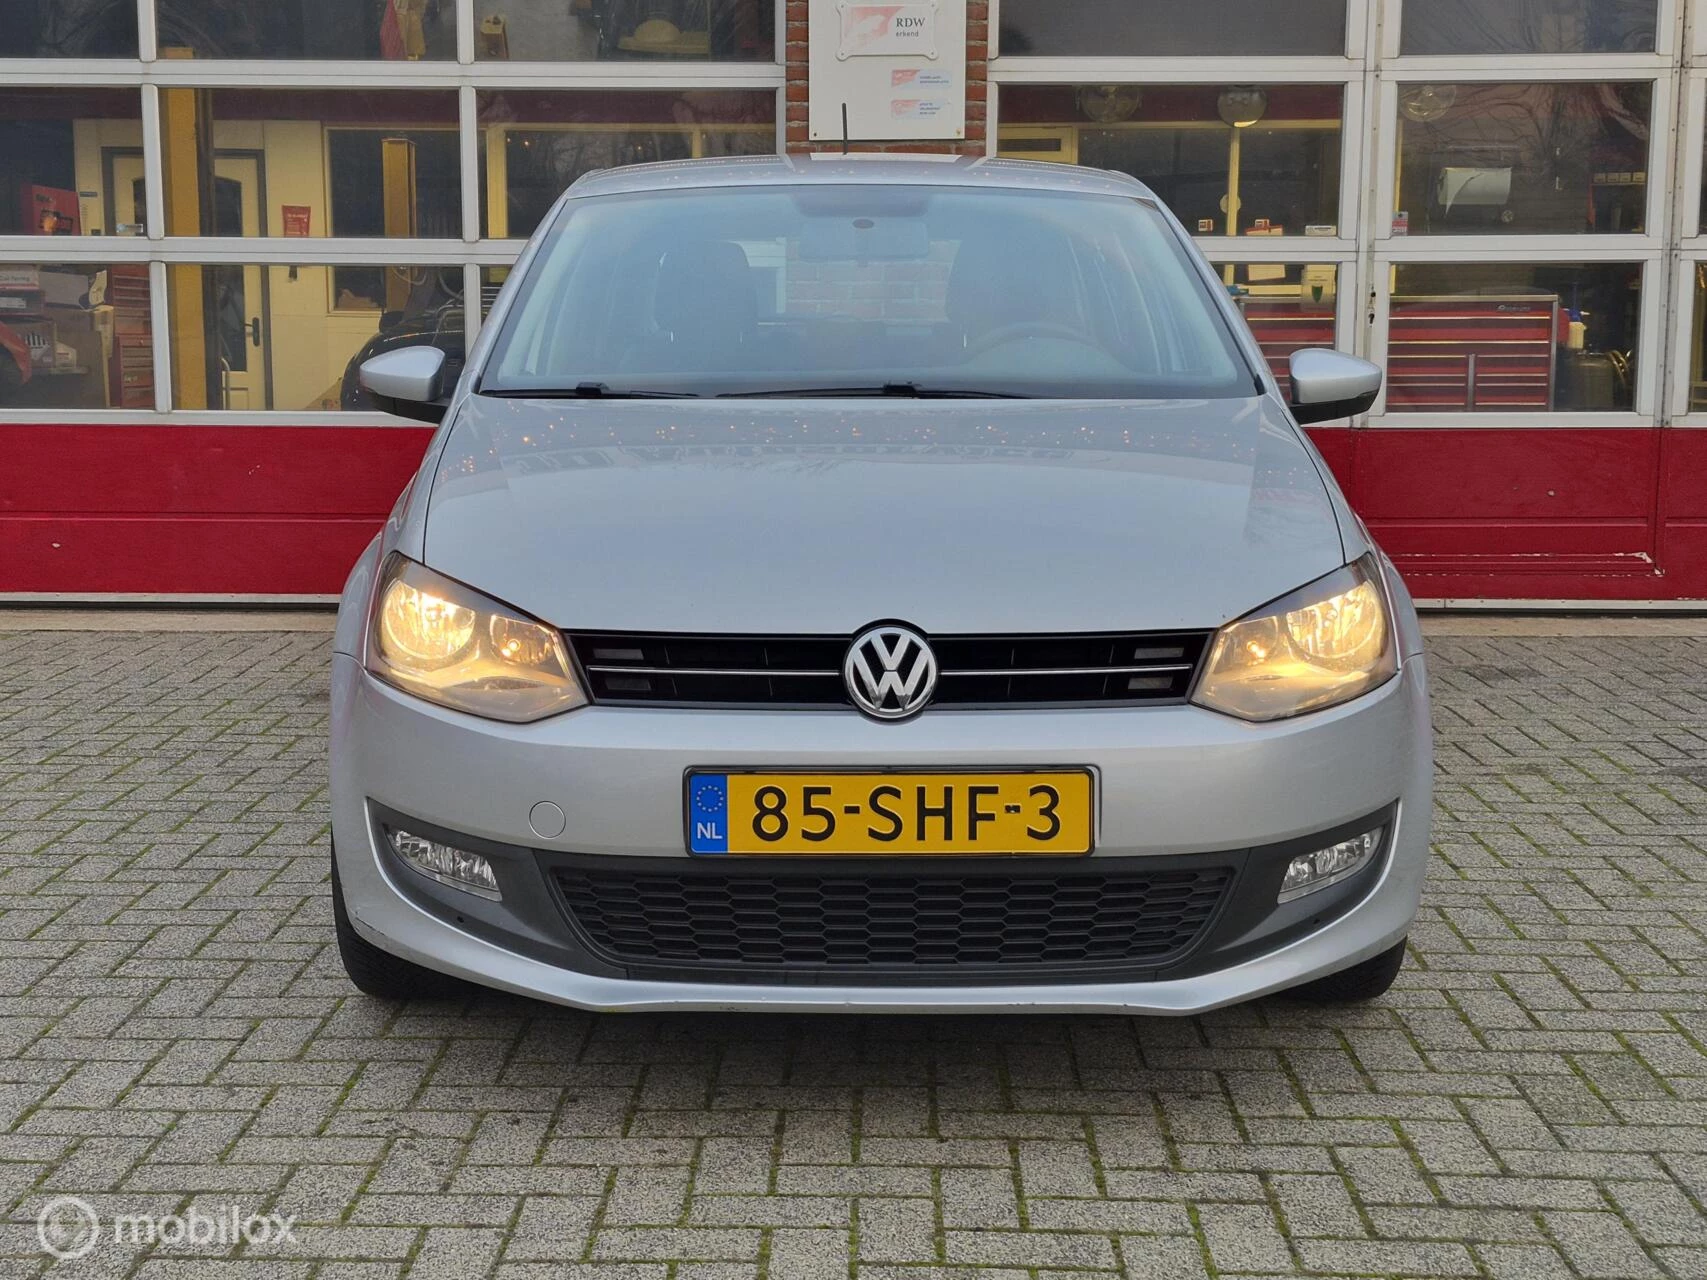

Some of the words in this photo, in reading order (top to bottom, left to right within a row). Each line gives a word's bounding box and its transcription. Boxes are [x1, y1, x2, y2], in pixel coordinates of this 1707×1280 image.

[896, 17, 926, 28] RDW
[752, 785, 1061, 842] 85-SHF-3
[696, 822, 723, 840] NL
